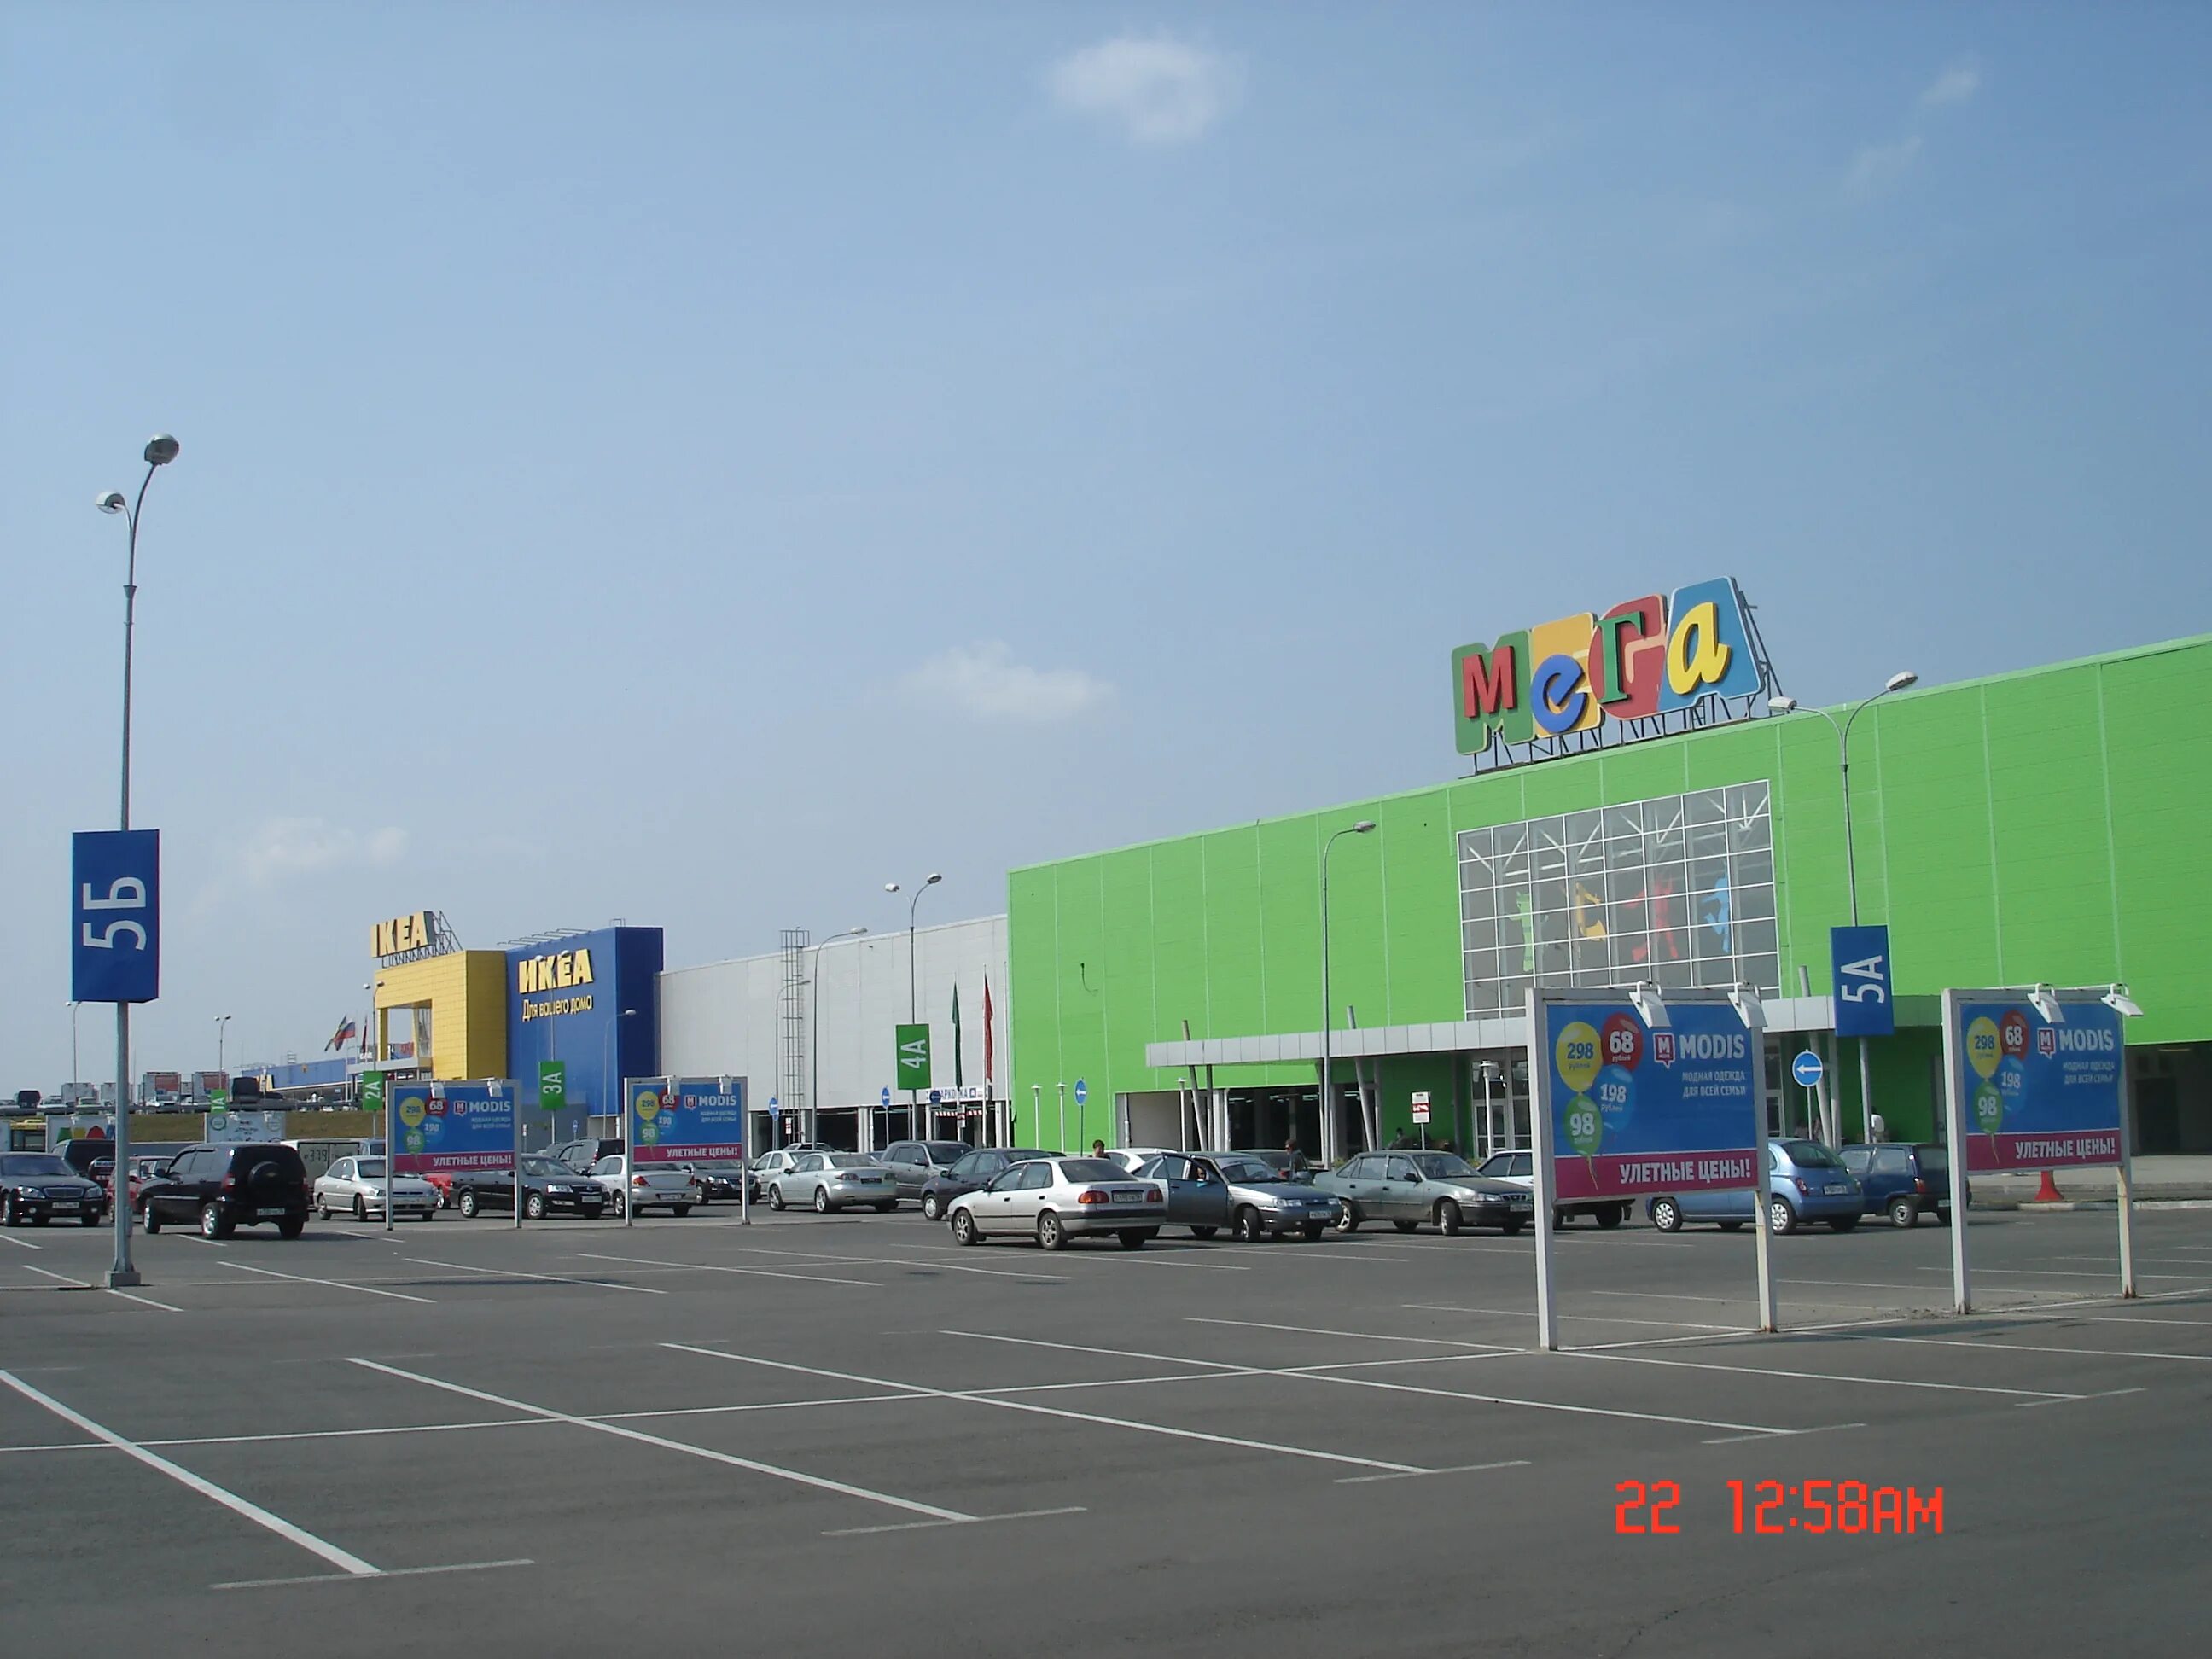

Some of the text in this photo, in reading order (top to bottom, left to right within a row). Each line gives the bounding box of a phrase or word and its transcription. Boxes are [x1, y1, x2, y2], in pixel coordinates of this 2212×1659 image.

[83, 876, 147, 951] 5Б
[370, 911, 429, 958] IKEA
[519, 948, 594, 994] ИКЕА
[1841, 955, 1884, 1004] 5А
[522, 999, 538, 1022] Для
[570, 995, 592, 1015] дома
[1609, 1030, 1634, 1054] 68
[1975, 1035, 1994, 1050] 298
[2006, 1025, 2023, 1045] 68
[2059, 1029, 2114, 1051] MODIS
[900, 1039, 927, 1069] 4А
[1567, 1042, 1594, 1060] 298
[1679, 1034, 1745, 1059] MODIS
[542, 1071, 562, 1094] 3А
[2001, 1071, 2021, 1088] 198
[662, 1094, 675, 1105] 68
[698, 1095, 737, 1107] MODIS
[1600, 1083, 1627, 1103] 198
[429, 1100, 444, 1111] 68
[469, 1101, 511, 1113] MODIS
[1978, 1096, 1997, 1116] 98
[1570, 1112, 1595, 1137] 98
[667, 1146, 738, 1158] УЛЕТНЫЕ ЦЕНЫ!
[2015, 1137, 2116, 1159] УЛЕТНЫЕ ЦЕНЫ!
[433, 1155, 512, 1167] УЛЕТНЫЕ ЦЕНЫ!
[1620, 1158, 1750, 1185] УЛЕТНЫЕ ЦЕНЫ!
